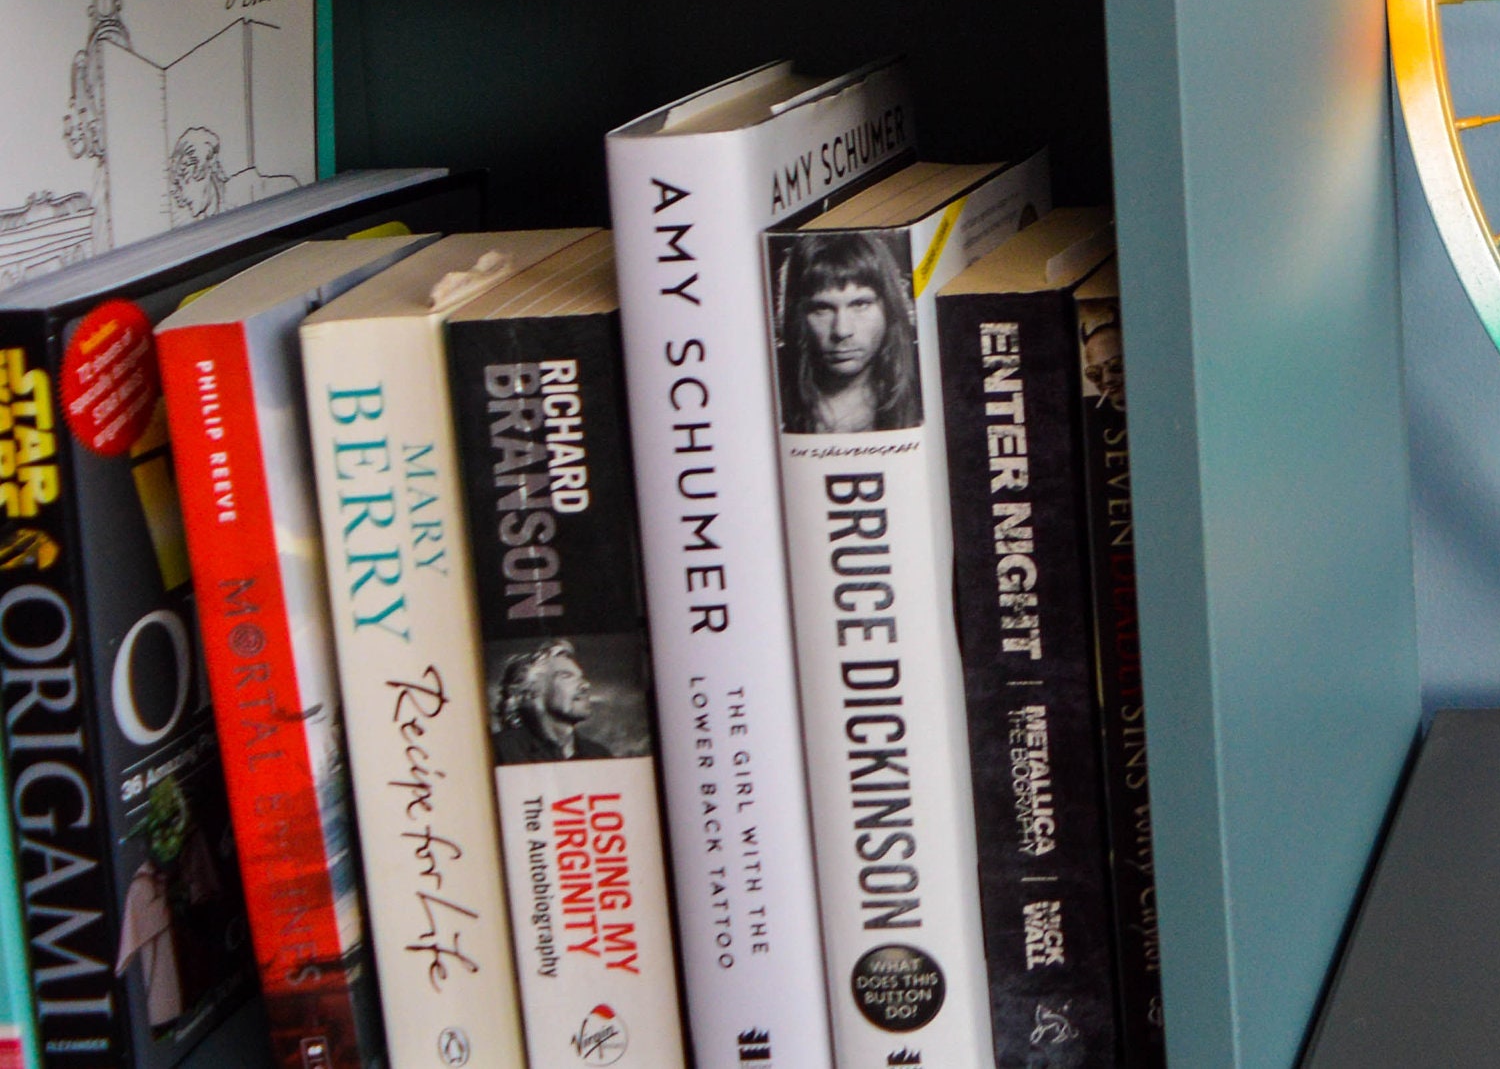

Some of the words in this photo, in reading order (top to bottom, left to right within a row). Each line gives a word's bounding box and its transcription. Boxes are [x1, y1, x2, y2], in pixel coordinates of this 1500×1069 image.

[770, 152, 814, 216] AMY
[822, 106, 906, 187] SCHUMER
[649, 177, 702, 308] AMY
[7, 346, 60, 518] STAR
[196, 359, 226, 440] PHILIP
[540, 359, 590, 514] RICHARD
[978, 321, 1030, 494] ENTER
[209, 451, 238, 524] REEVE
[327, 380, 411, 645] BERRY
[402, 442, 447, 577] MARY
[483, 361, 564, 621] BRANSON
[665, 338, 730, 636] SCHUMER
[823, 471, 901, 648] BRUCE
[990, 502, 1042, 661] NIGHT
[1103, 426, 1133, 548] SEVEN
[1120, 704, 1149, 791] SINS
[217, 577, 285, 773] MORTAL
[688, 675, 715, 770] LOWER
[726, 686, 749, 736] THE
[1007, 706, 1028, 745] THE
[385, 664, 450, 821] Recipe
[732, 752, 755, 813] GIRL
[840, 658, 923, 932] DICKINSON
[1024, 704, 1056, 857] METALLICA
[0, 583, 113, 1020] ORIGAMI
[522, 795, 543, 832] The
[585, 792, 633, 913] LOSING
[701, 784, 724, 854] BACK
[1010, 746, 1036, 857] BIOGRAPHY
[400, 824, 464, 890] for
[528, 839, 560, 979] Autobiography
[550, 793, 602, 959] VIRGINITY
[741, 826, 763, 894] WITH
[404, 890, 480, 995] Life
[602, 921, 641, 975] MY
[708, 867, 735, 970] TATTOO
[747, 906, 770, 956] THE
[870, 957, 922, 973] WHAT
[1022, 899, 1048, 970] WALL
[1043, 899, 1065, 966] MICK
[855, 974, 898, 990] DOES
[902, 971, 939, 987] THIS
[863, 988, 933, 1005] BUTTON
